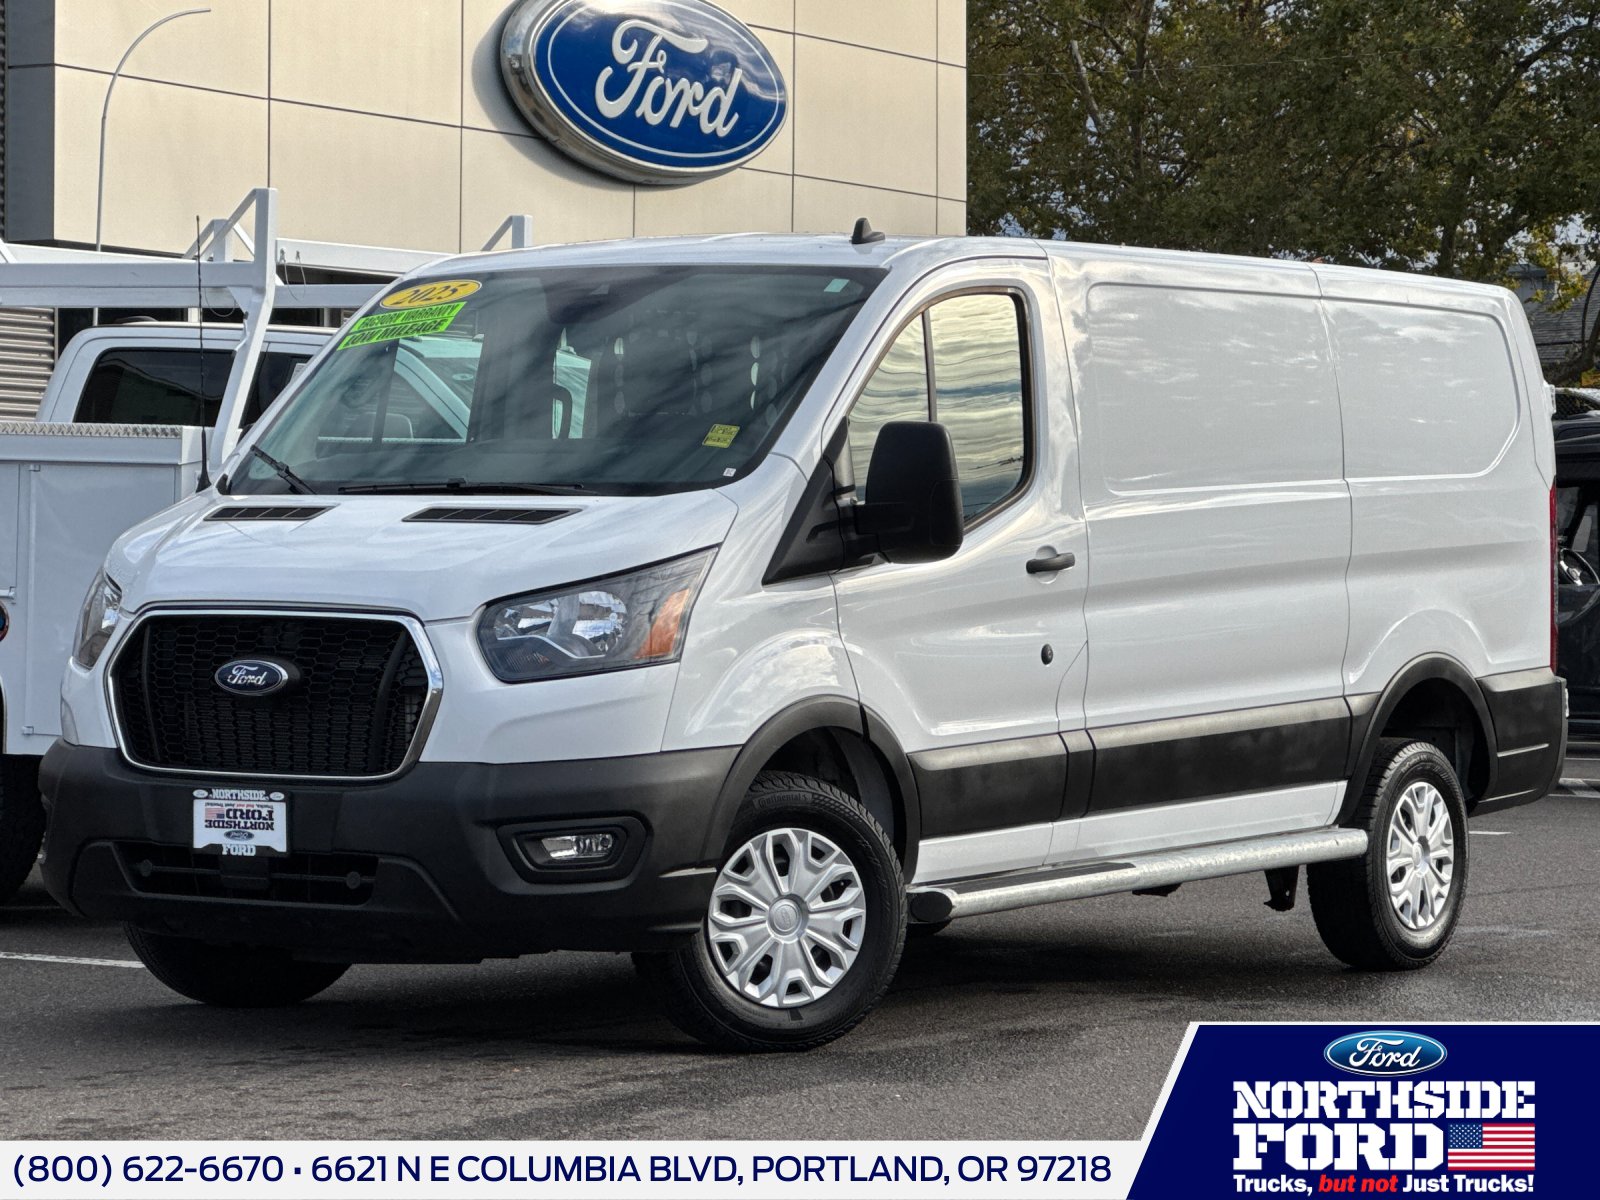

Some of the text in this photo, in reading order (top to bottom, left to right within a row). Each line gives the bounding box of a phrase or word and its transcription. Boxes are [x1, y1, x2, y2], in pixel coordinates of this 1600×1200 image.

[595, 19, 742, 137] Ford
[391, 283, 469, 306] 2025
[401, 303, 460, 323] WARRANTY
[344, 318, 448, 347] LOW MILEAGE
[227, 664, 268, 686] Ford
[211, 789, 266, 801] NORTHSIDE
[226, 808, 274, 821] FORD
[204, 819, 275, 831] NORTHSIDE
[222, 844, 256, 856] FORD
